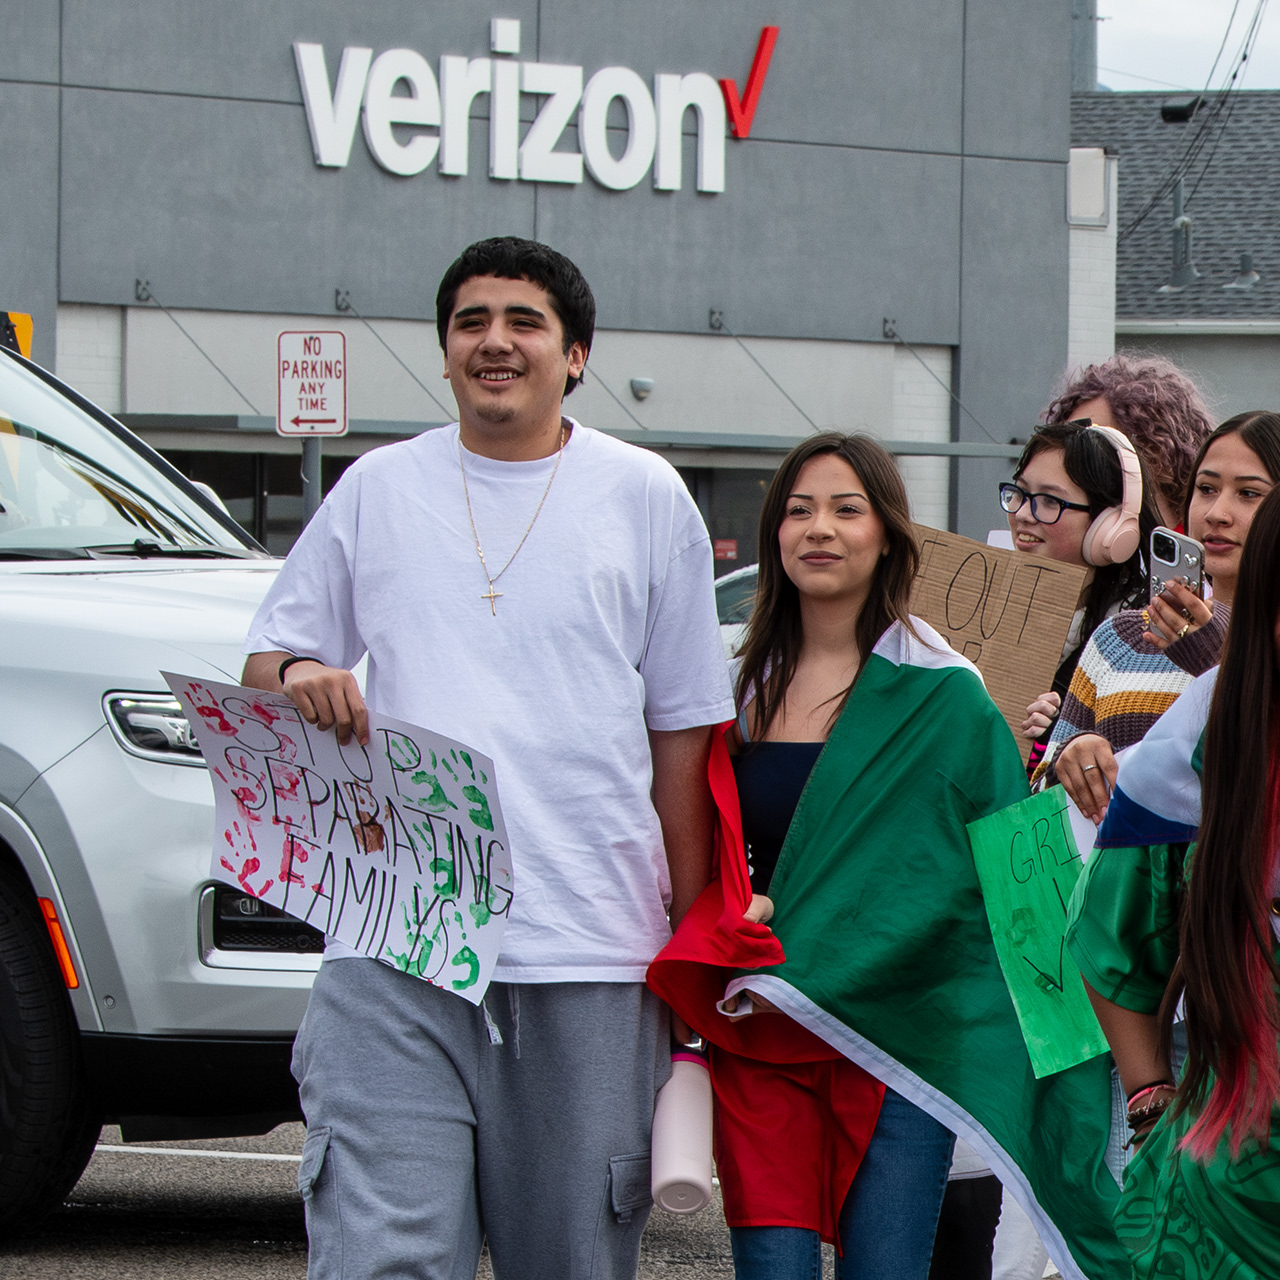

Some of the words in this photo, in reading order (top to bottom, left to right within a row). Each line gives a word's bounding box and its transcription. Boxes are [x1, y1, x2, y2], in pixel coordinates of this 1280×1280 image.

[293, 18, 726, 193] verizon
[281, 360, 342, 379] PARKING
[303, 336, 322, 356] NO
[297, 398, 328, 411] TIME
[299, 382, 326, 395] ANY
[945, 551, 1061, 644] OUT
[222, 697, 422, 797] STOP
[224, 745, 514, 919] SEPARATING
